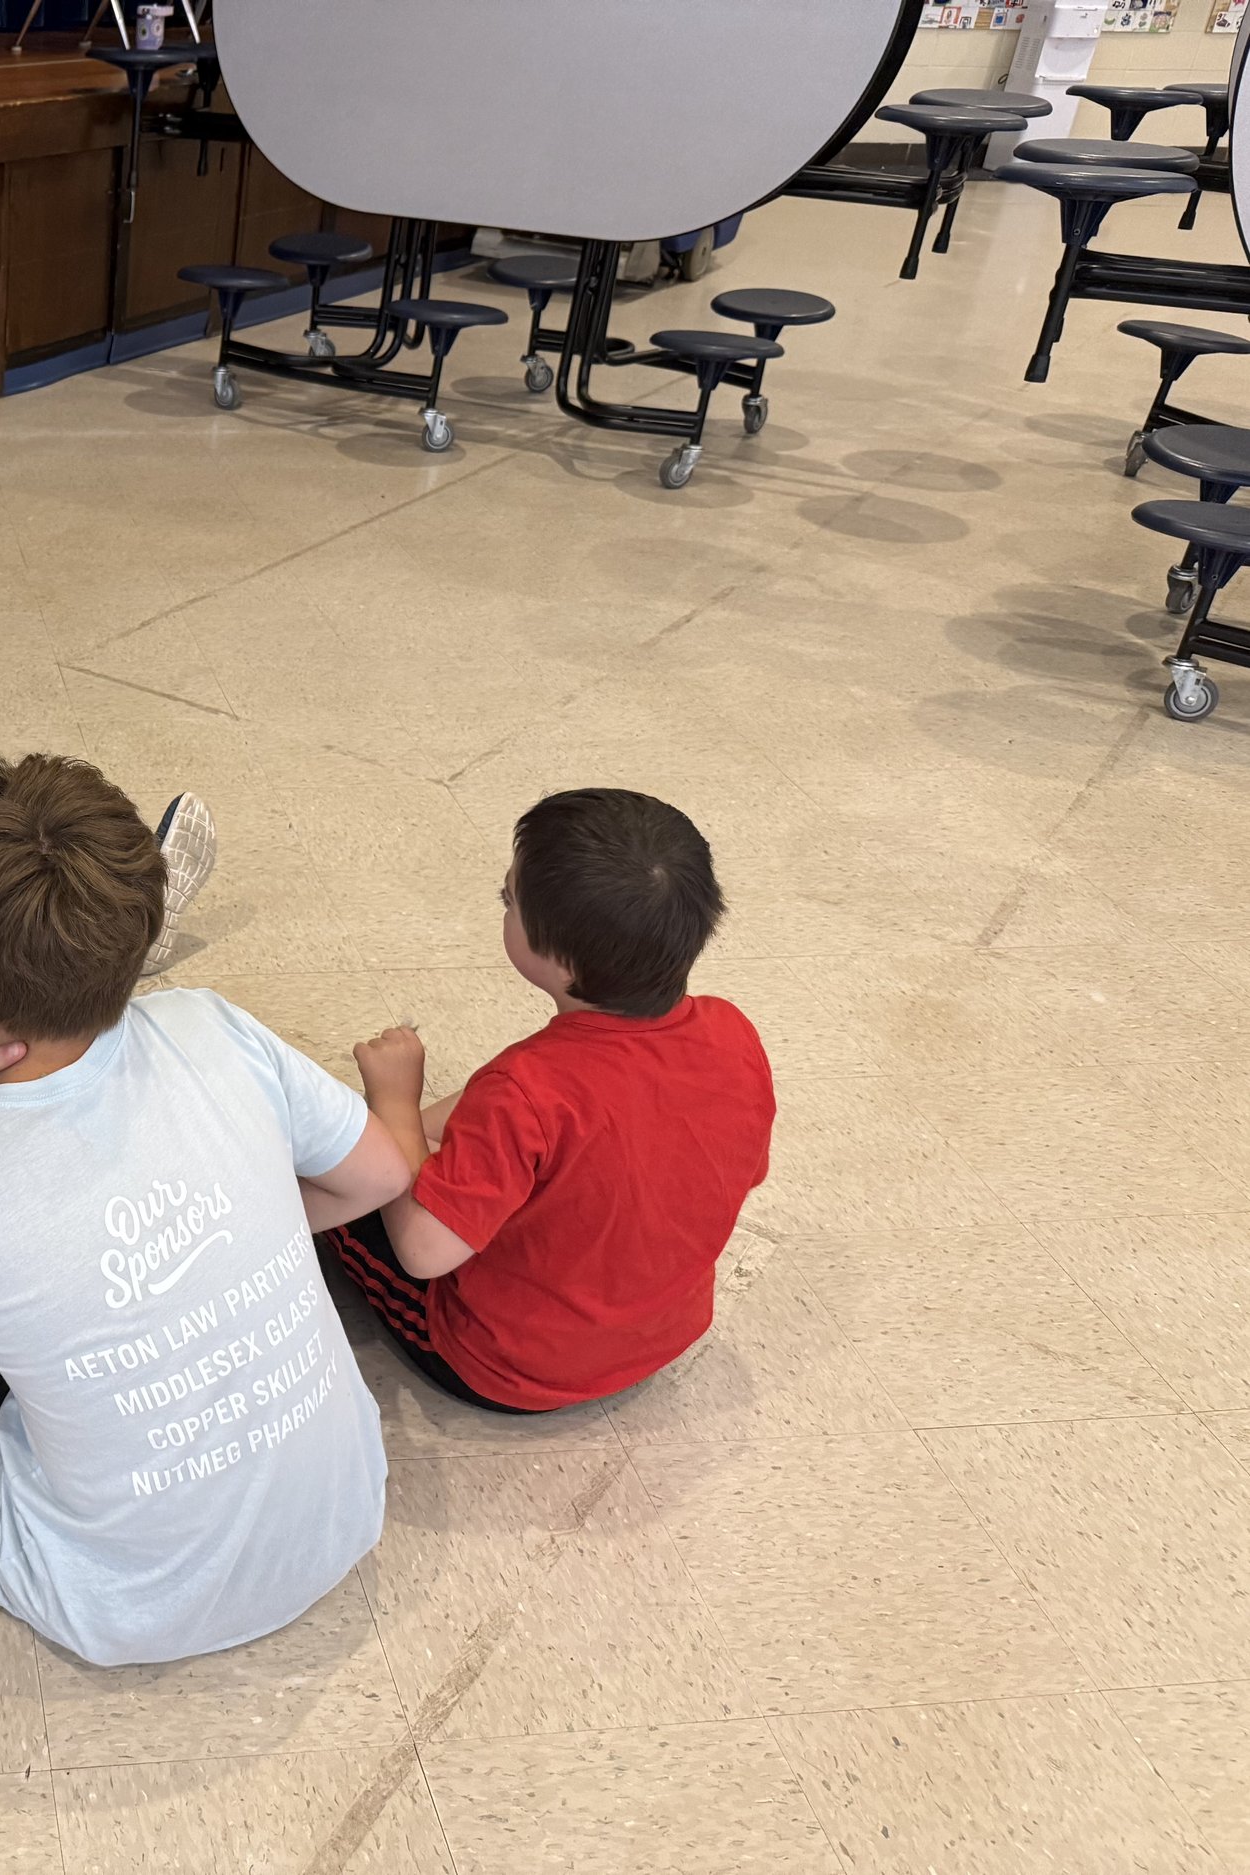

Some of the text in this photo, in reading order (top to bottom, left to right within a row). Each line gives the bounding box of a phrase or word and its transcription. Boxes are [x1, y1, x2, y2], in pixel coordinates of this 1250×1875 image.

[99, 1182, 232, 1309] Sponsors
[104, 1179, 187, 1245] Our
[64, 1334, 160, 1381] AETON
[162, 1299, 218, 1351] LAW
[113, 1279, 318, 1416] MIDDLESEX GLASS
[147, 1328, 324, 1450] COPPER SKILLET
[130, 1351, 338, 1496] NUTMEG PHARMACY
